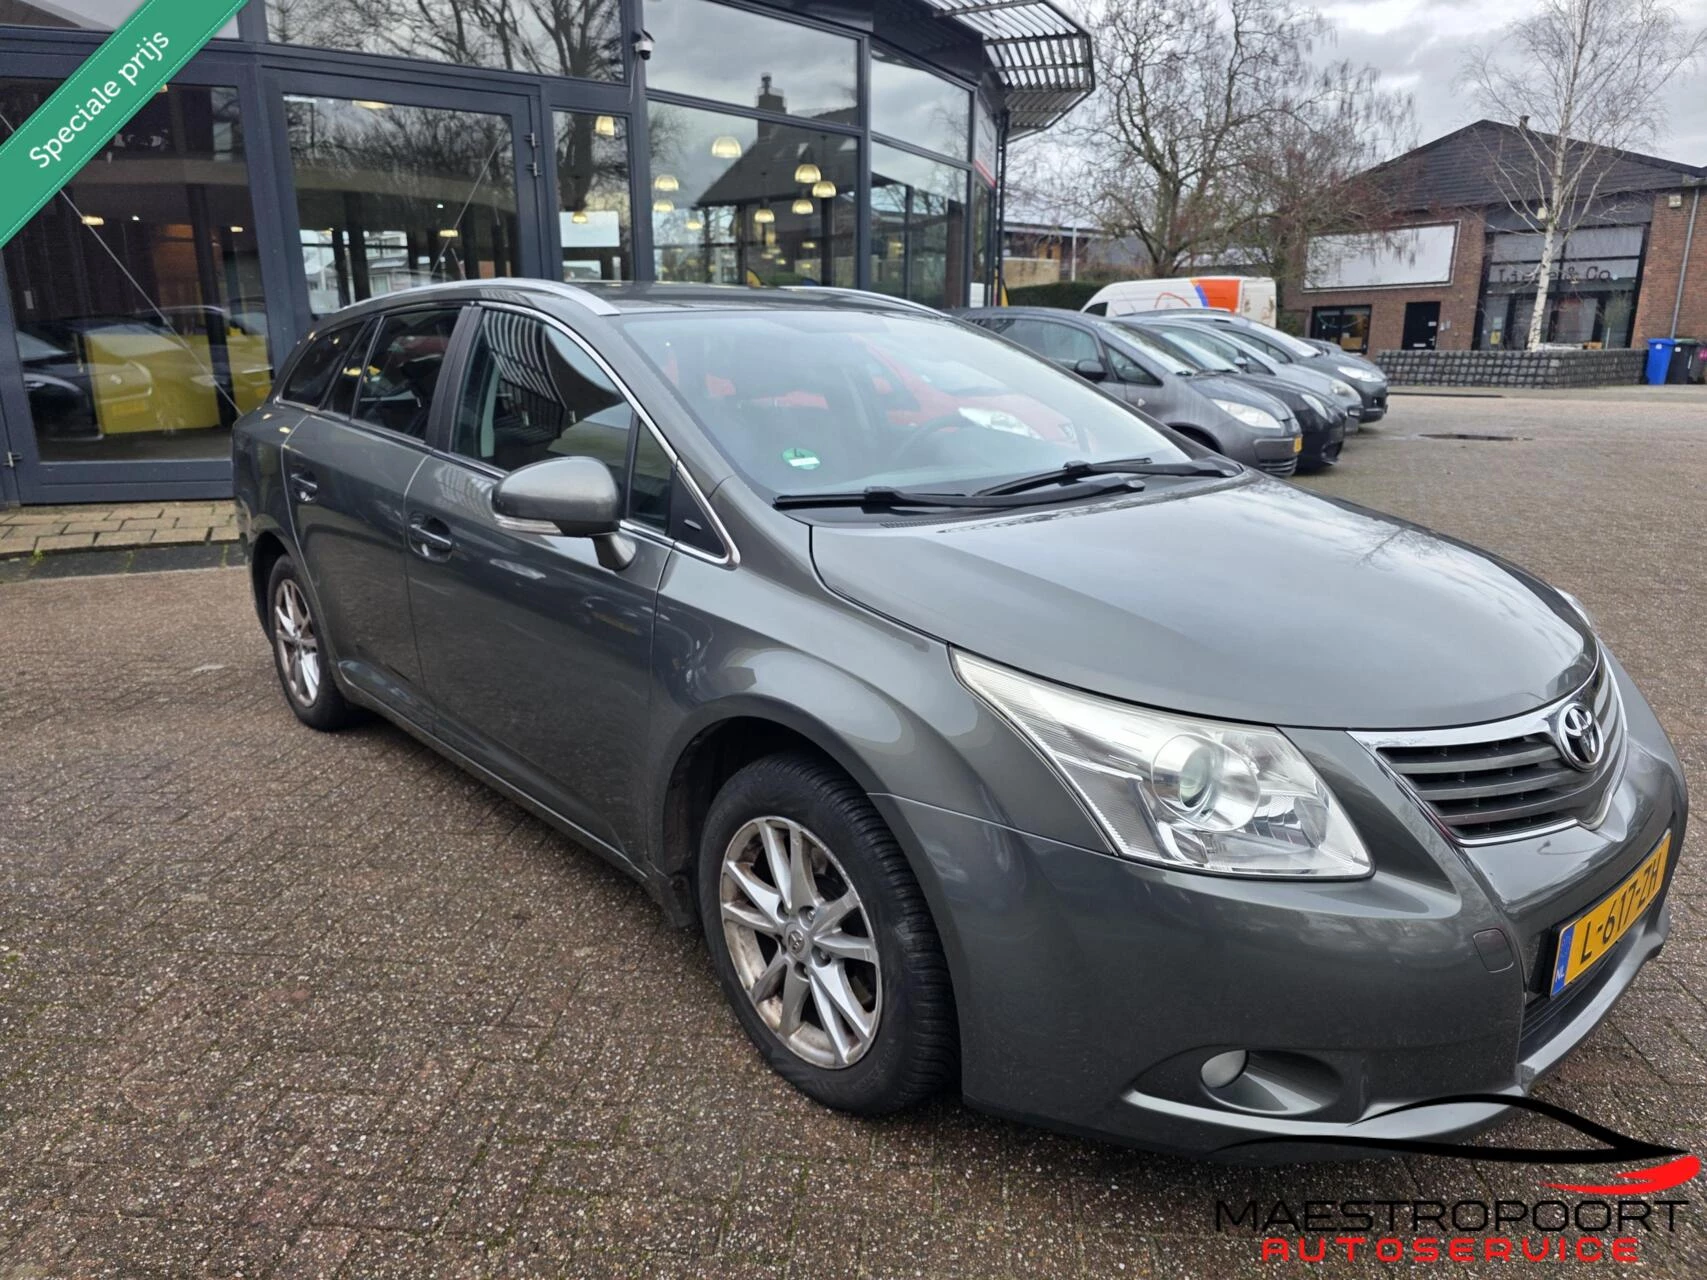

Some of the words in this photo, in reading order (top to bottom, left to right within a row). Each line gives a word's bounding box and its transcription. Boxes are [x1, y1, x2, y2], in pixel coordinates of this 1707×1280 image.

[1586, 266, 1612, 282] Co
[1580, 853, 1661, 965] L-617-ZH
[1556, 965, 1565, 981] NL
